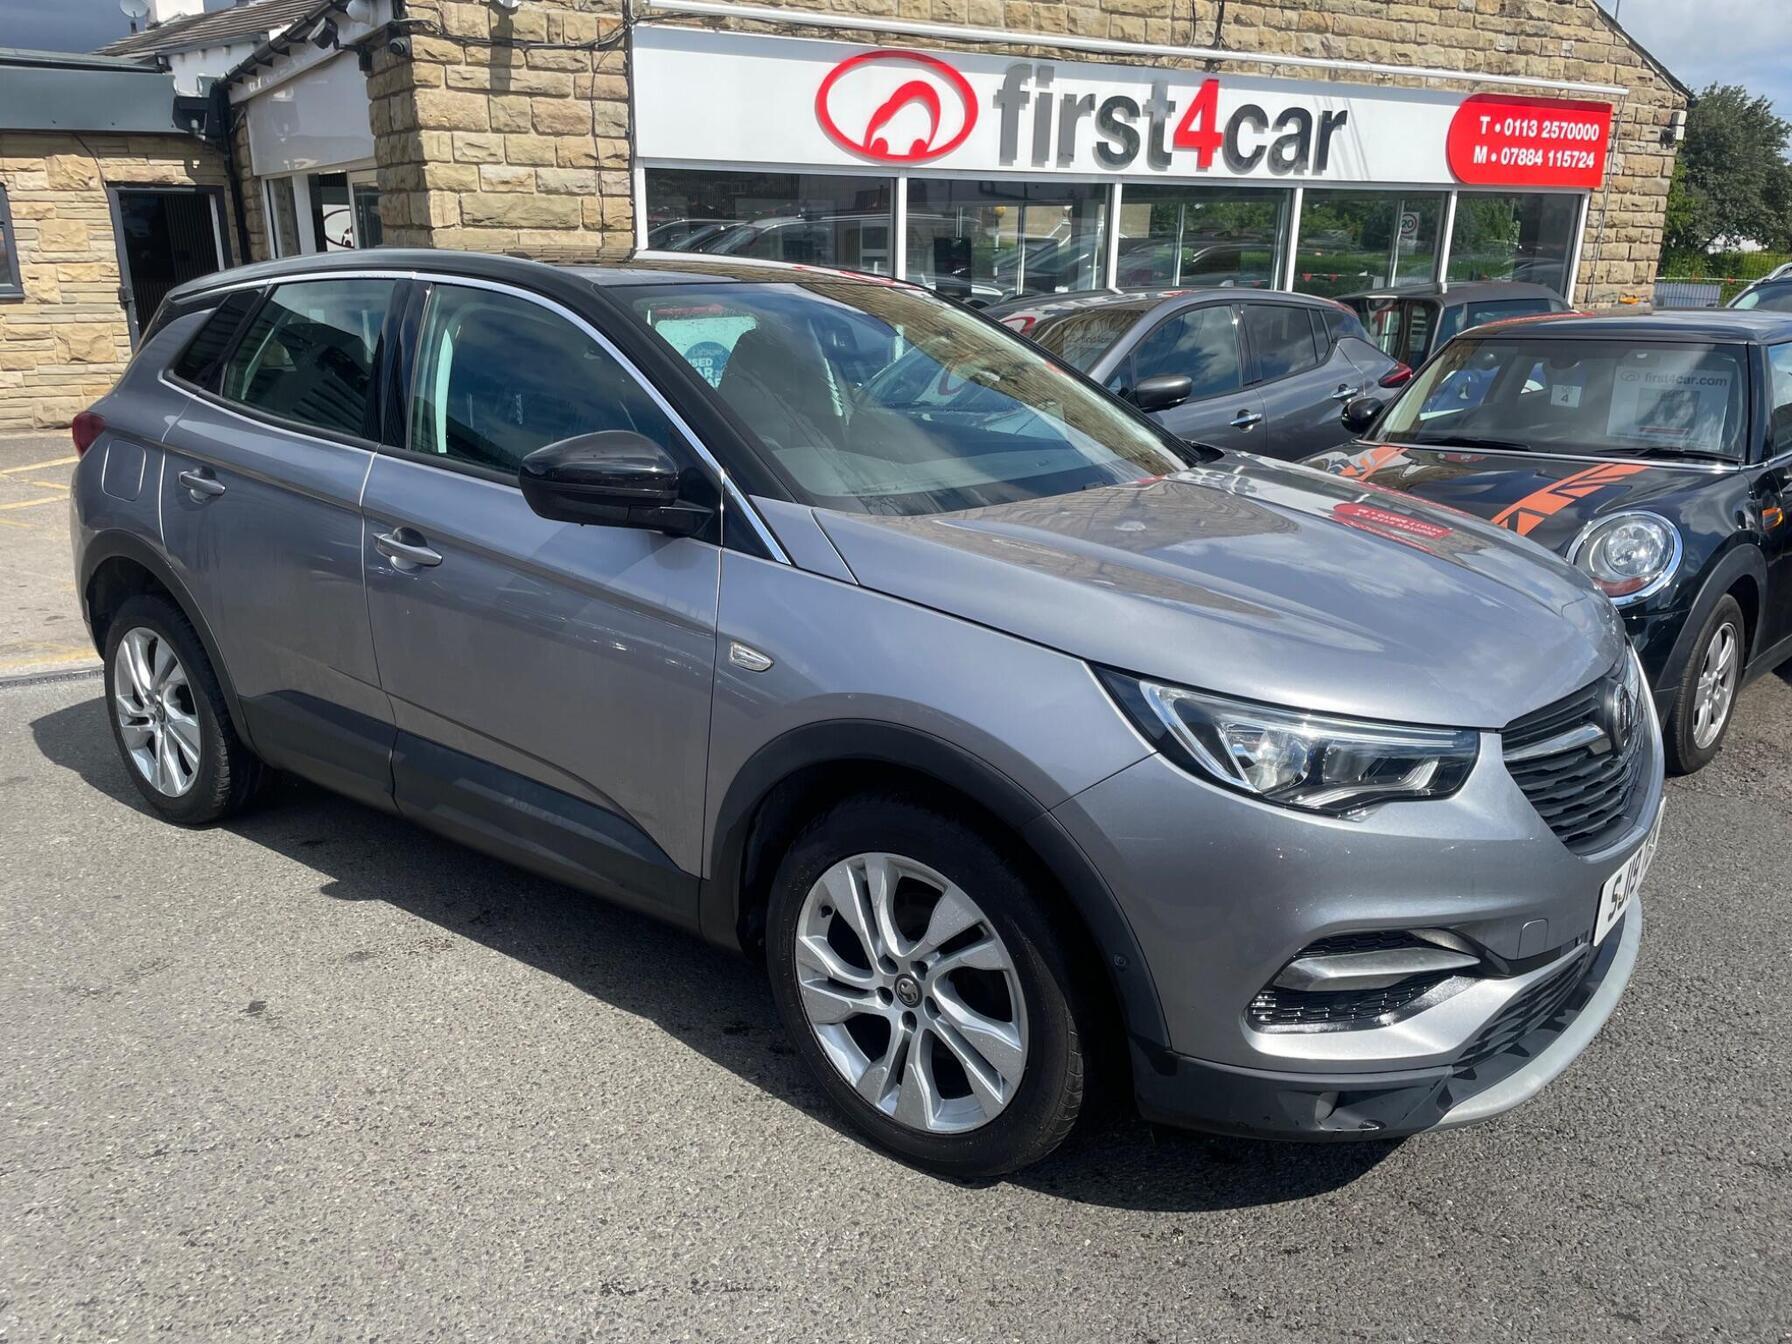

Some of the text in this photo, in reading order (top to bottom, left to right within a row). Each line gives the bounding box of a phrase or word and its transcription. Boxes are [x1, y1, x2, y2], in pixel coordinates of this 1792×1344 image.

[992, 63, 1347, 174] first4car
[1480, 116, 1599, 141] T 0113 2570000
[1473, 145, 1595, 168] M 07884 115724
